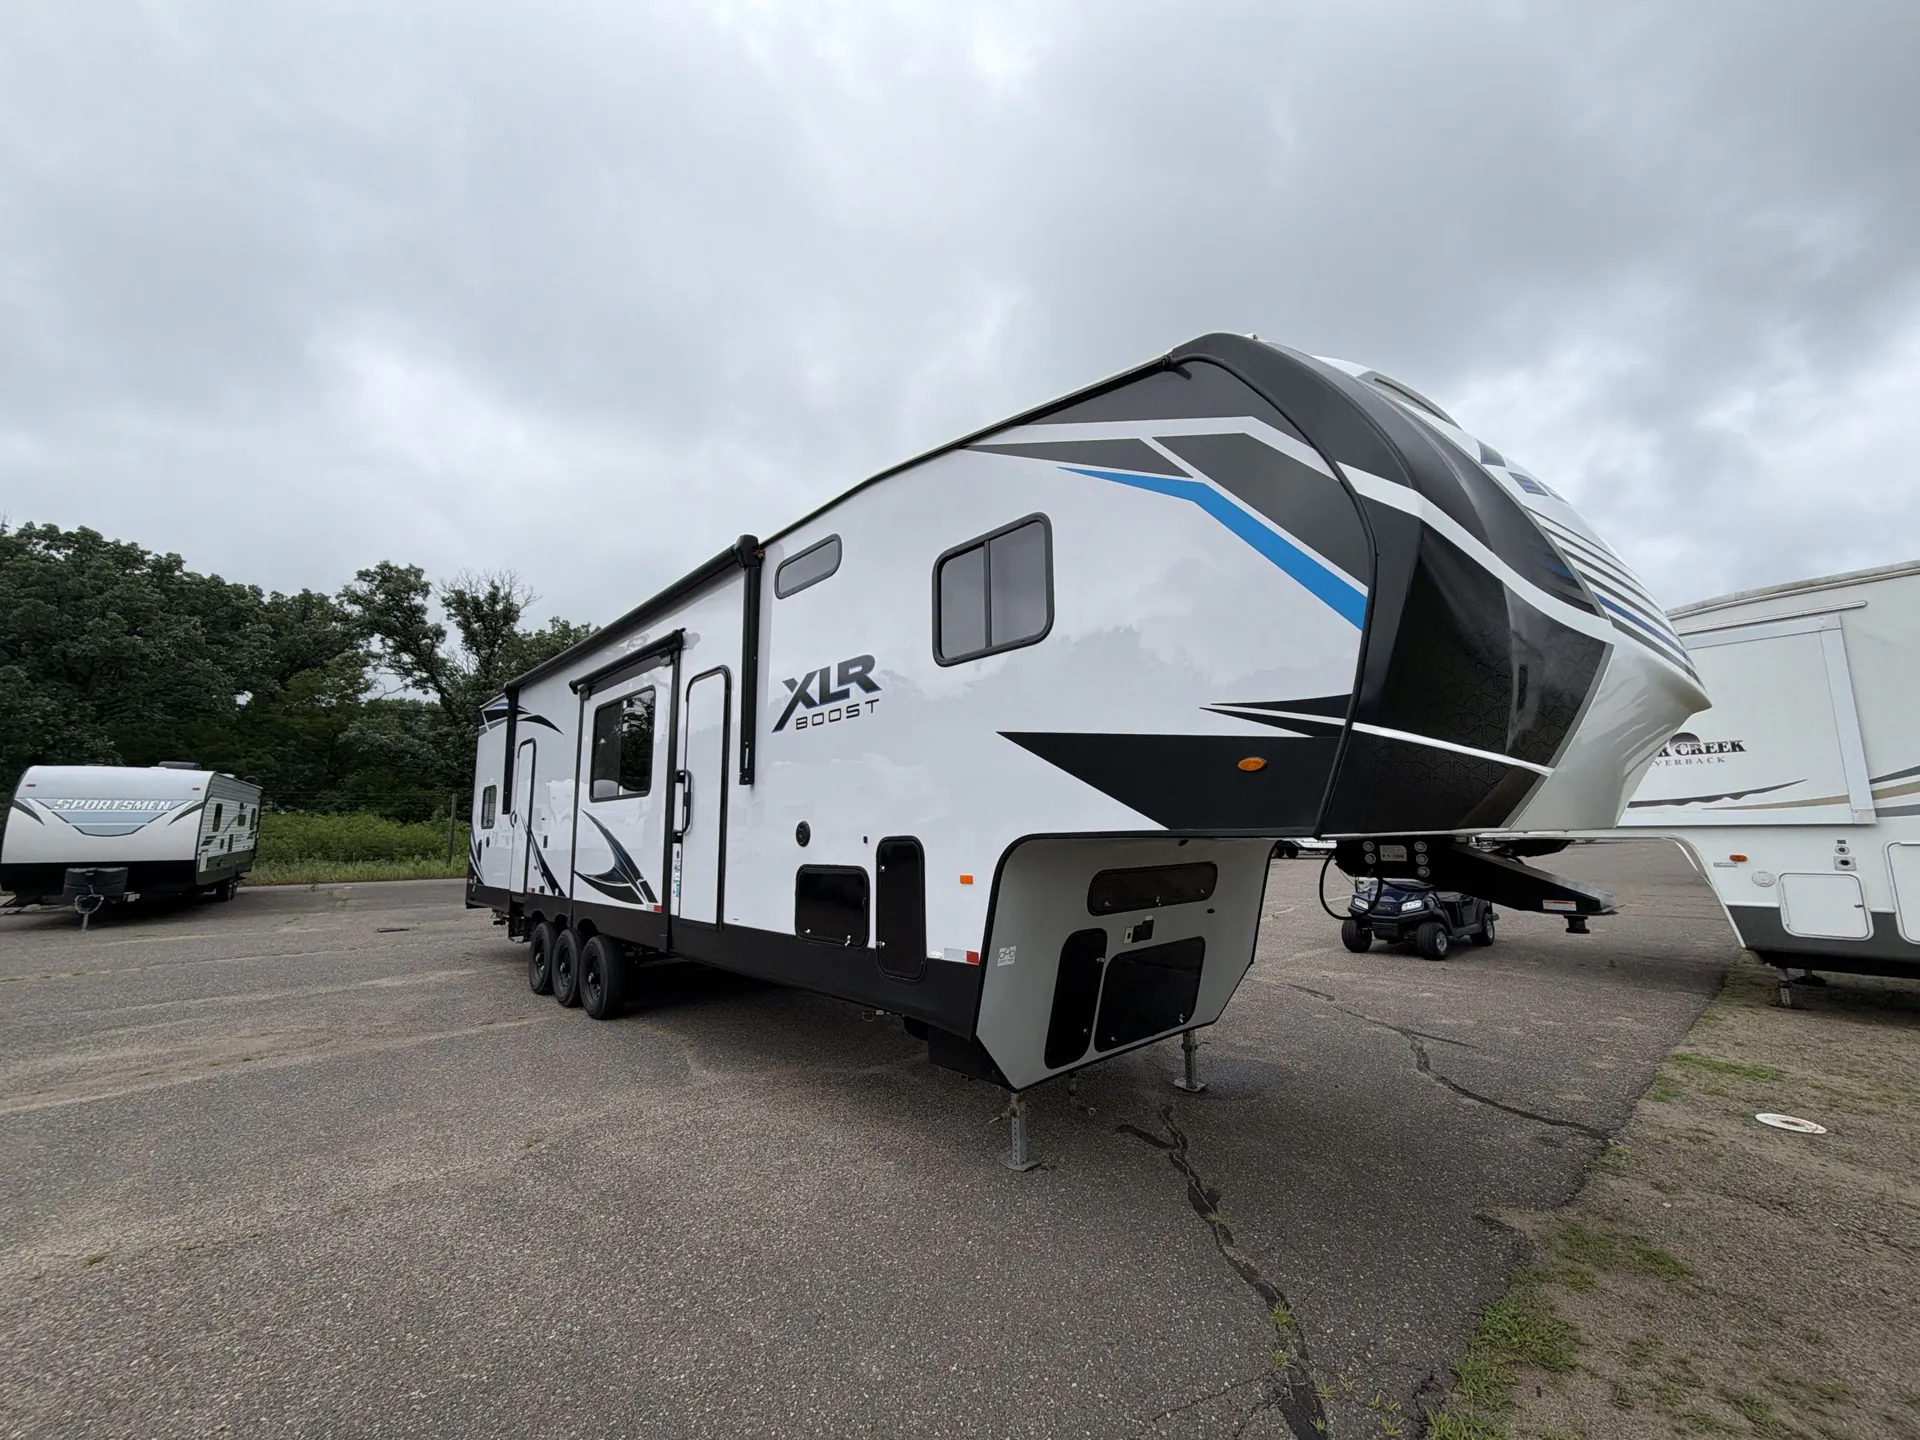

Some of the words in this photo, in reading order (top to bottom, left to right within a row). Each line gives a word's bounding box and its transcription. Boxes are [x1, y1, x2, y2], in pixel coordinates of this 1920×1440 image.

[771, 654, 882, 733] XLR
[796, 698, 880, 730] BOOST
[1675, 740, 1746, 756] CREEK
[1654, 756, 1726, 767] VERBACK
[53, 799, 172, 811] SPORTSMEN
